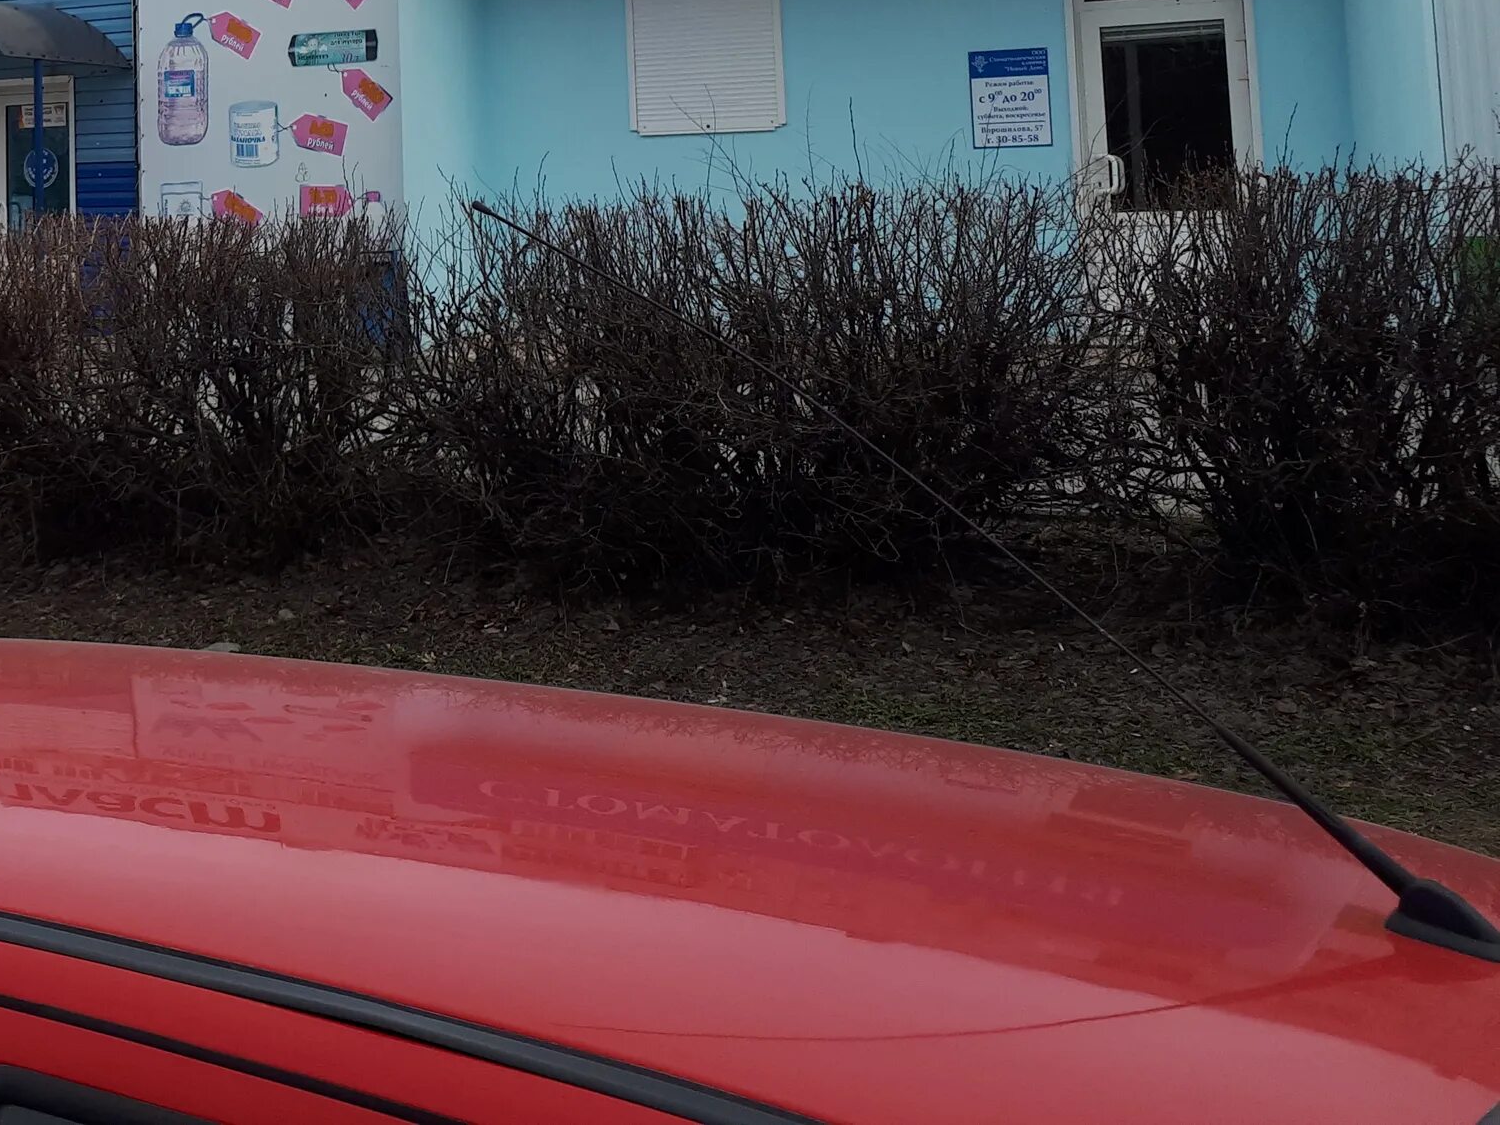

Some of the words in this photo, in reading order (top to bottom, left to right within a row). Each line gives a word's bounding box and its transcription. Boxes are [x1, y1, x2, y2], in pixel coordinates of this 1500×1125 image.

[221, 34, 245, 52] рублей
[351, 89, 374, 111] рублей
[307, 137, 334, 151] рублей
